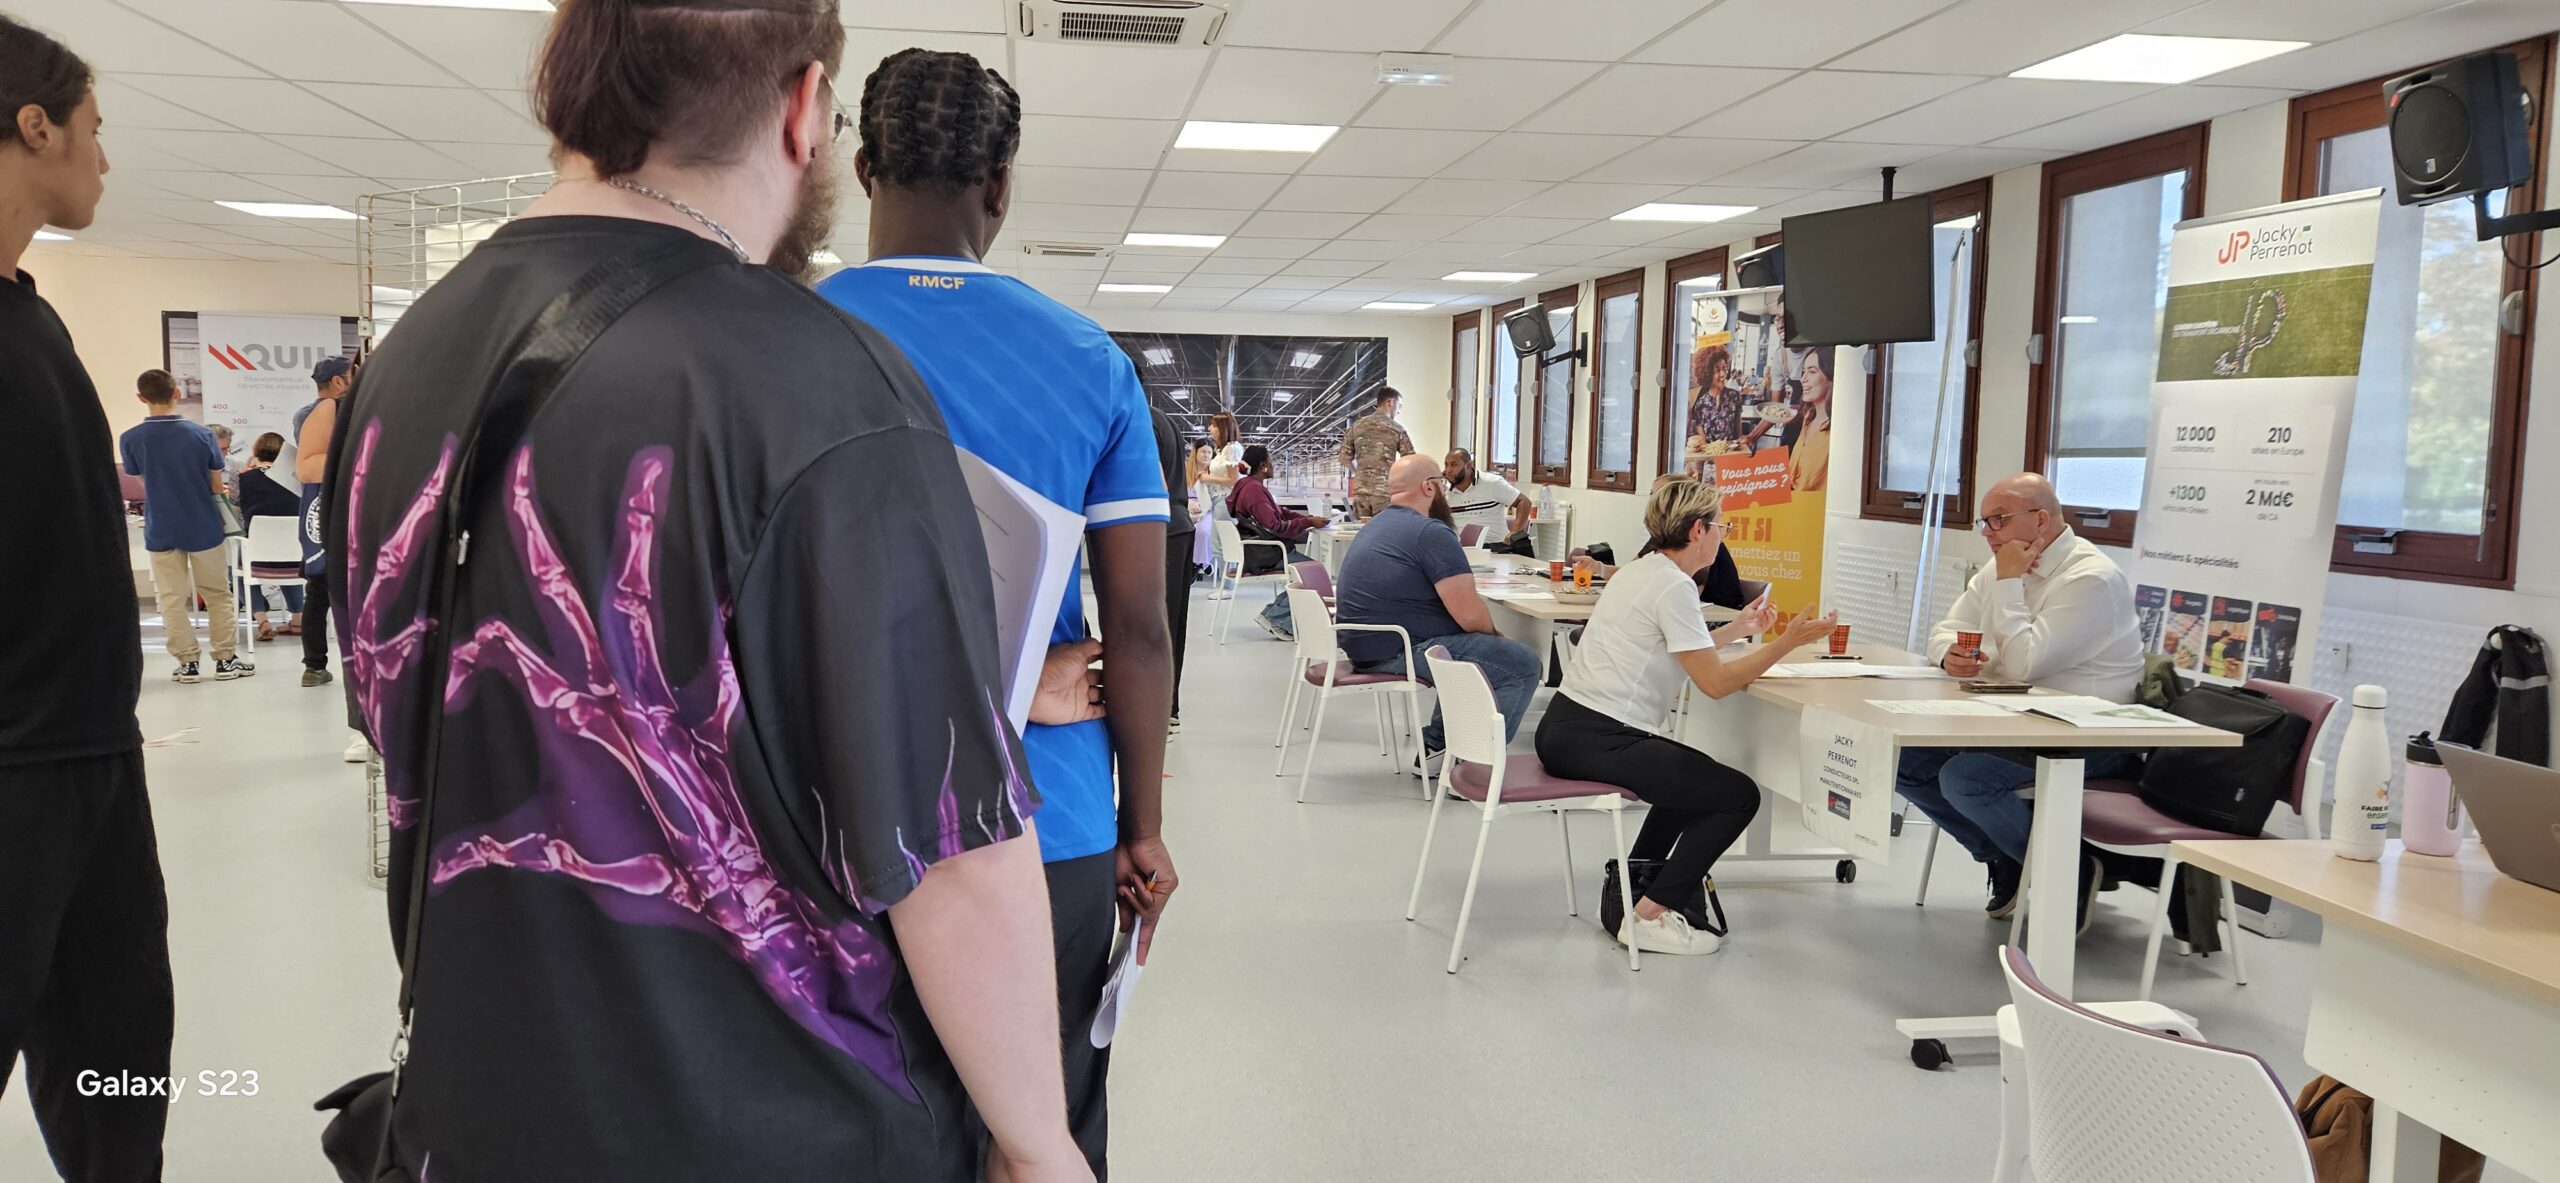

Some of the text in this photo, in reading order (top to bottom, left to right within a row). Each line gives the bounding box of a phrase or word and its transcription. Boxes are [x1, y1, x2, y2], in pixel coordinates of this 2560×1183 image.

[2252, 224, 2297, 244] Jacky
[2250, 239, 2313, 261] Perrenot
[908, 275, 965, 290] RMCF
[2267, 427, 2292, 443] 210
[1754, 463, 1786, 475] nous
[1719, 479, 1778, 497] rejoignez
[2169, 485, 2206, 501] +1300
[2245, 489, 2294, 507] 2 Md€
[1753, 517, 1773, 542] SI
[1783, 550, 1802, 562] un
[1739, 563, 1802, 580] vous chez
[1834, 734, 1854, 748] JACKY
[1828, 750, 1857, 768] PERRENOT
